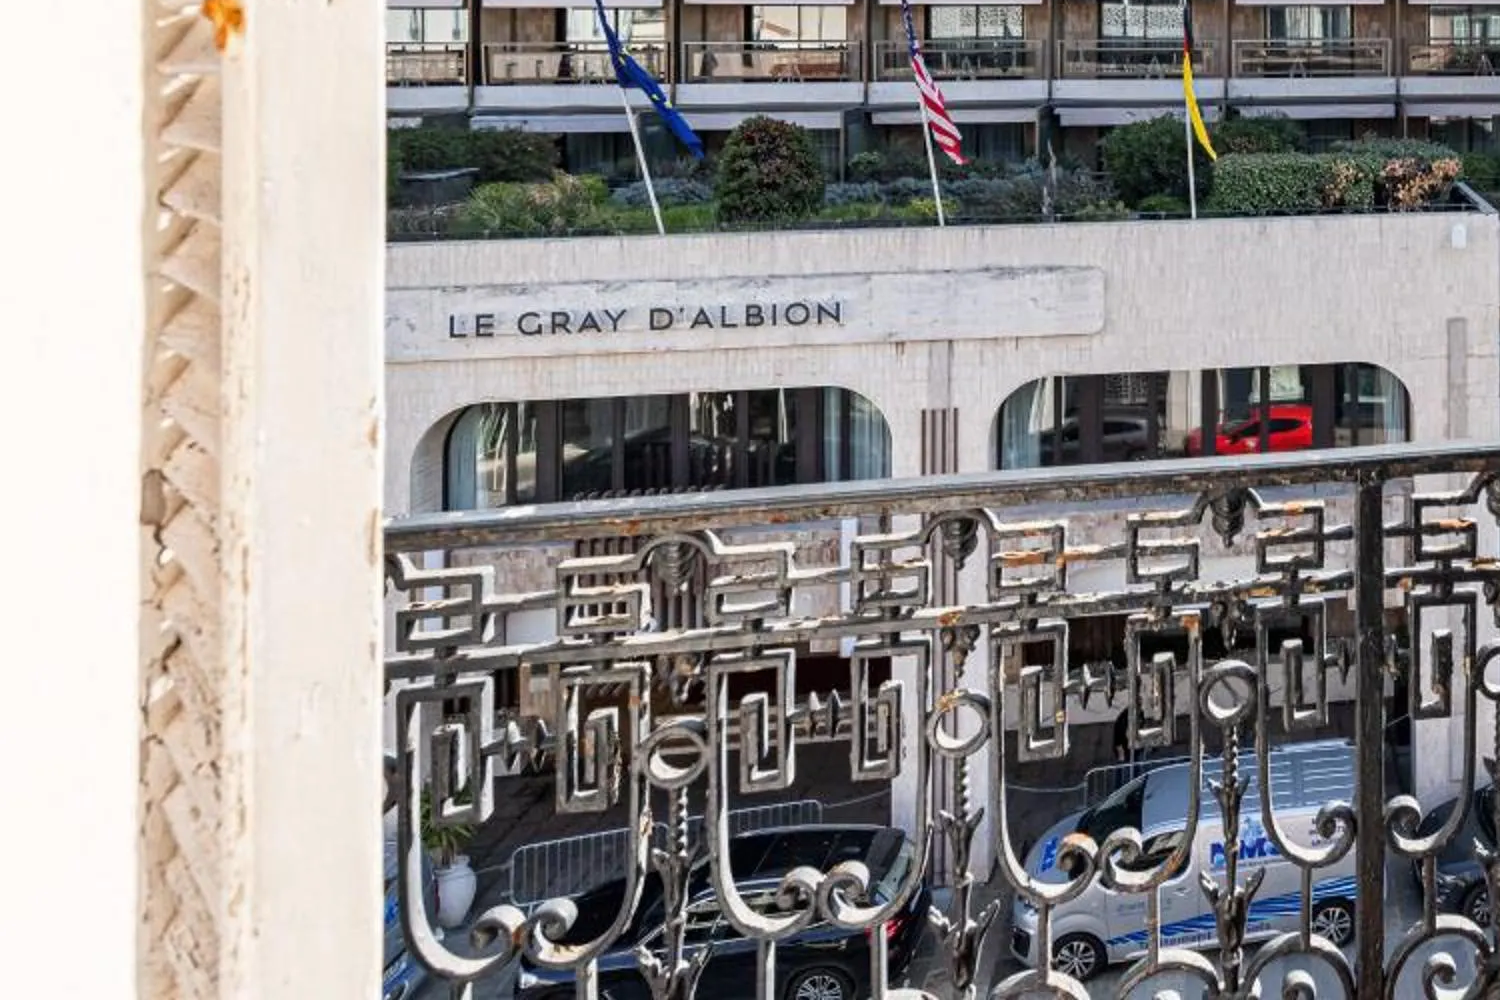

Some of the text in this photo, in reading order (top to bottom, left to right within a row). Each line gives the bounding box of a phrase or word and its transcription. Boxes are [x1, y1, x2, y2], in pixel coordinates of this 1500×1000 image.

[448, 301, 842, 339] LE GRAY D'ALBION
